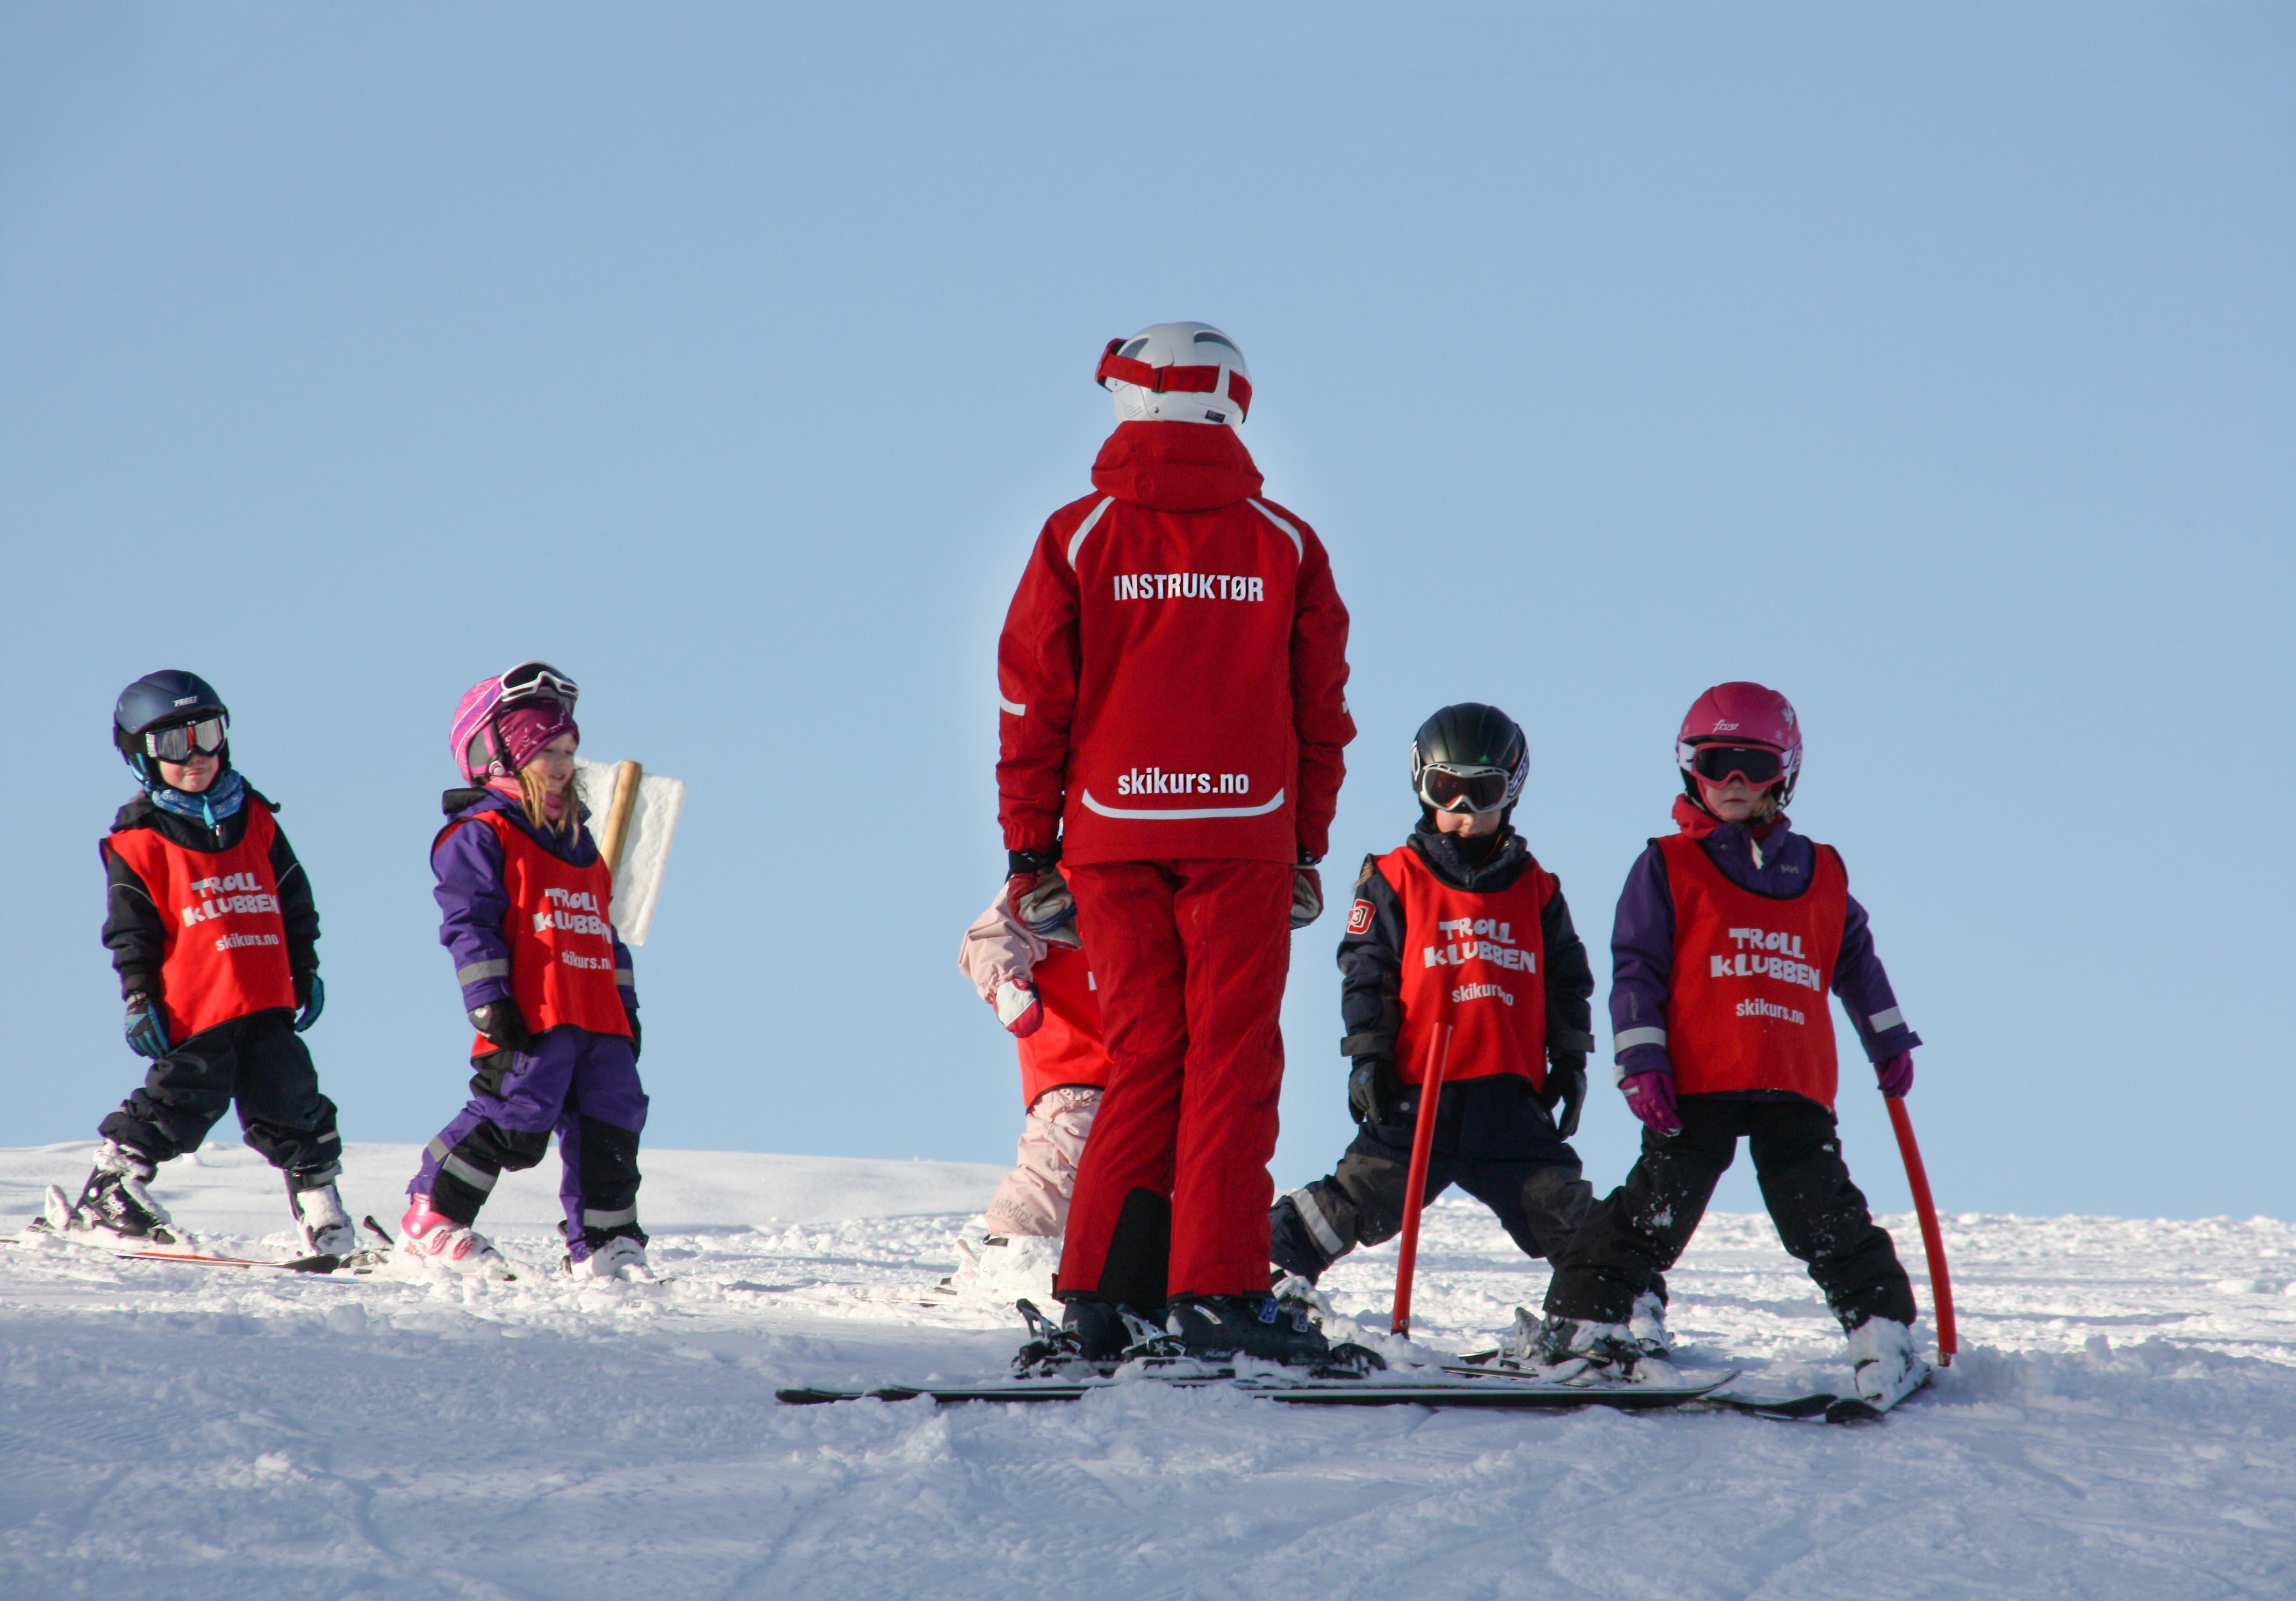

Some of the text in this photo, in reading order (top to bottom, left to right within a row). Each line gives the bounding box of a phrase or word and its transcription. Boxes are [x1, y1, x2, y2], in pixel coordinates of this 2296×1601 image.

[1114, 572, 1264, 601] INSTRUKTØR
[1118, 767, 1249, 795] skikurs.no
[191, 872, 263, 898] TROLL
[182, 894, 281, 927] KLUBBEN
[216, 933, 279, 951] skikurs.no
[1439, 917, 1516, 944] TROLL
[1729, 928, 1806, 959] TROLL
[1424, 941, 1536, 974] KLUBBEN
[1710, 953, 1821, 992] KLUBBEN
[1736, 999, 1805, 1025] skikurs.no
